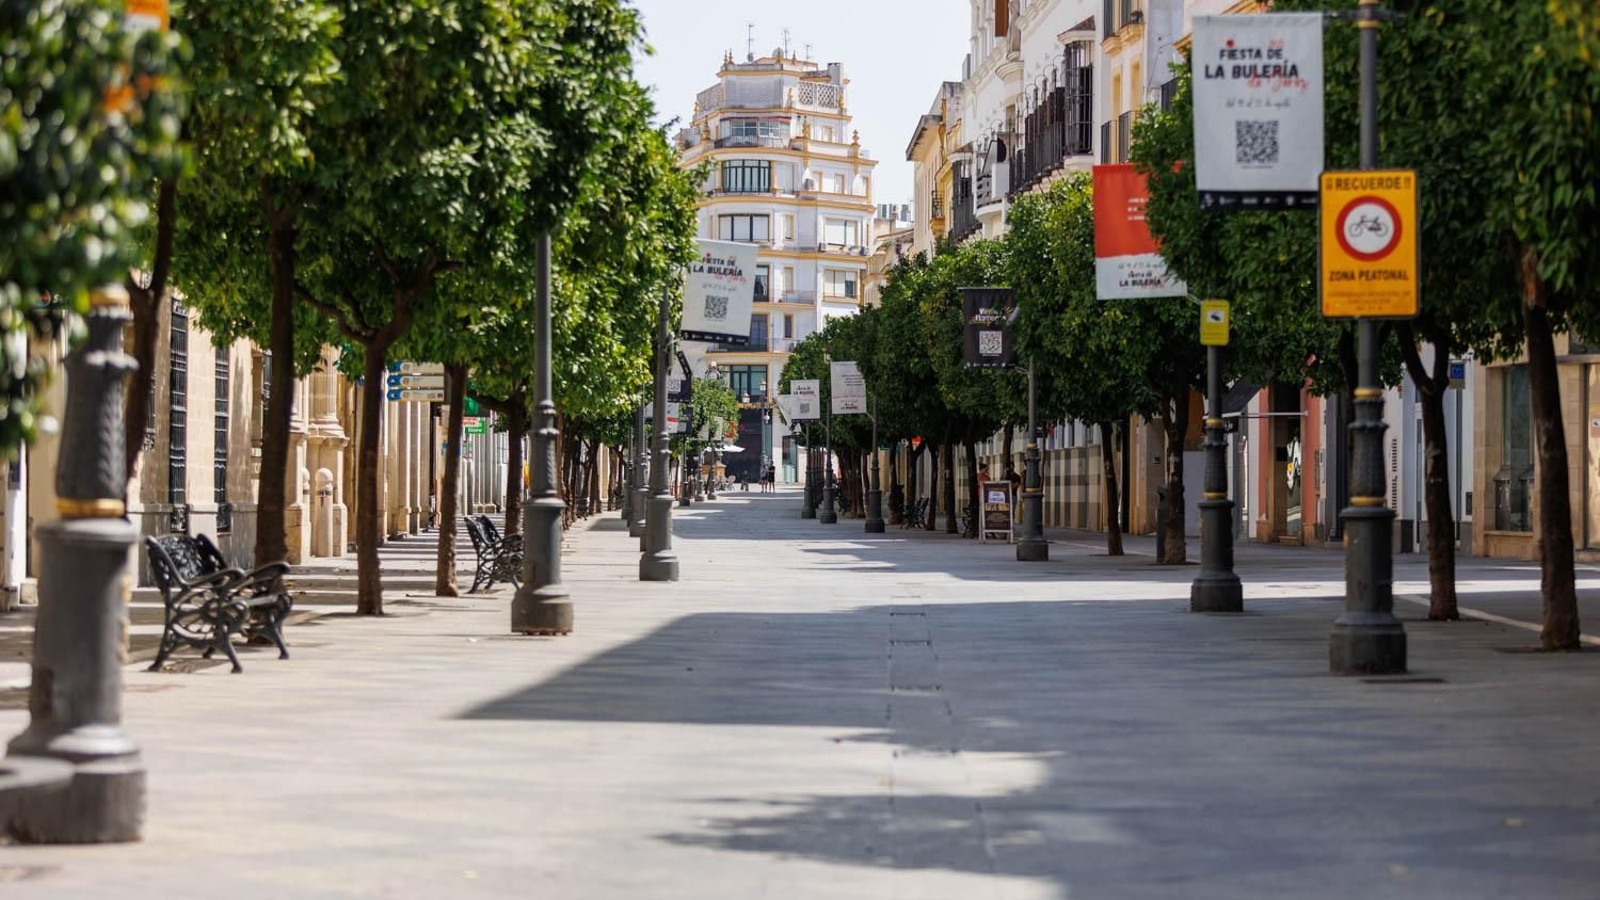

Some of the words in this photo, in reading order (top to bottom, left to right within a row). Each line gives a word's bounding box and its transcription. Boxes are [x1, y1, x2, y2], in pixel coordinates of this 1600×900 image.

[1219, 48, 1263, 60] FIESTA
[1267, 48, 1284, 60] DE
[1204, 64, 1225, 79] LA
[1232, 60, 1299, 79] BULERÍA
[693, 264, 704, 273] LA
[707, 266, 743, 277] BULERÍA
[1329, 271, 1356, 282] ZONA
[1358, 270, 1409, 282] PEATONAL
[1119, 279, 1129, 287] LA
